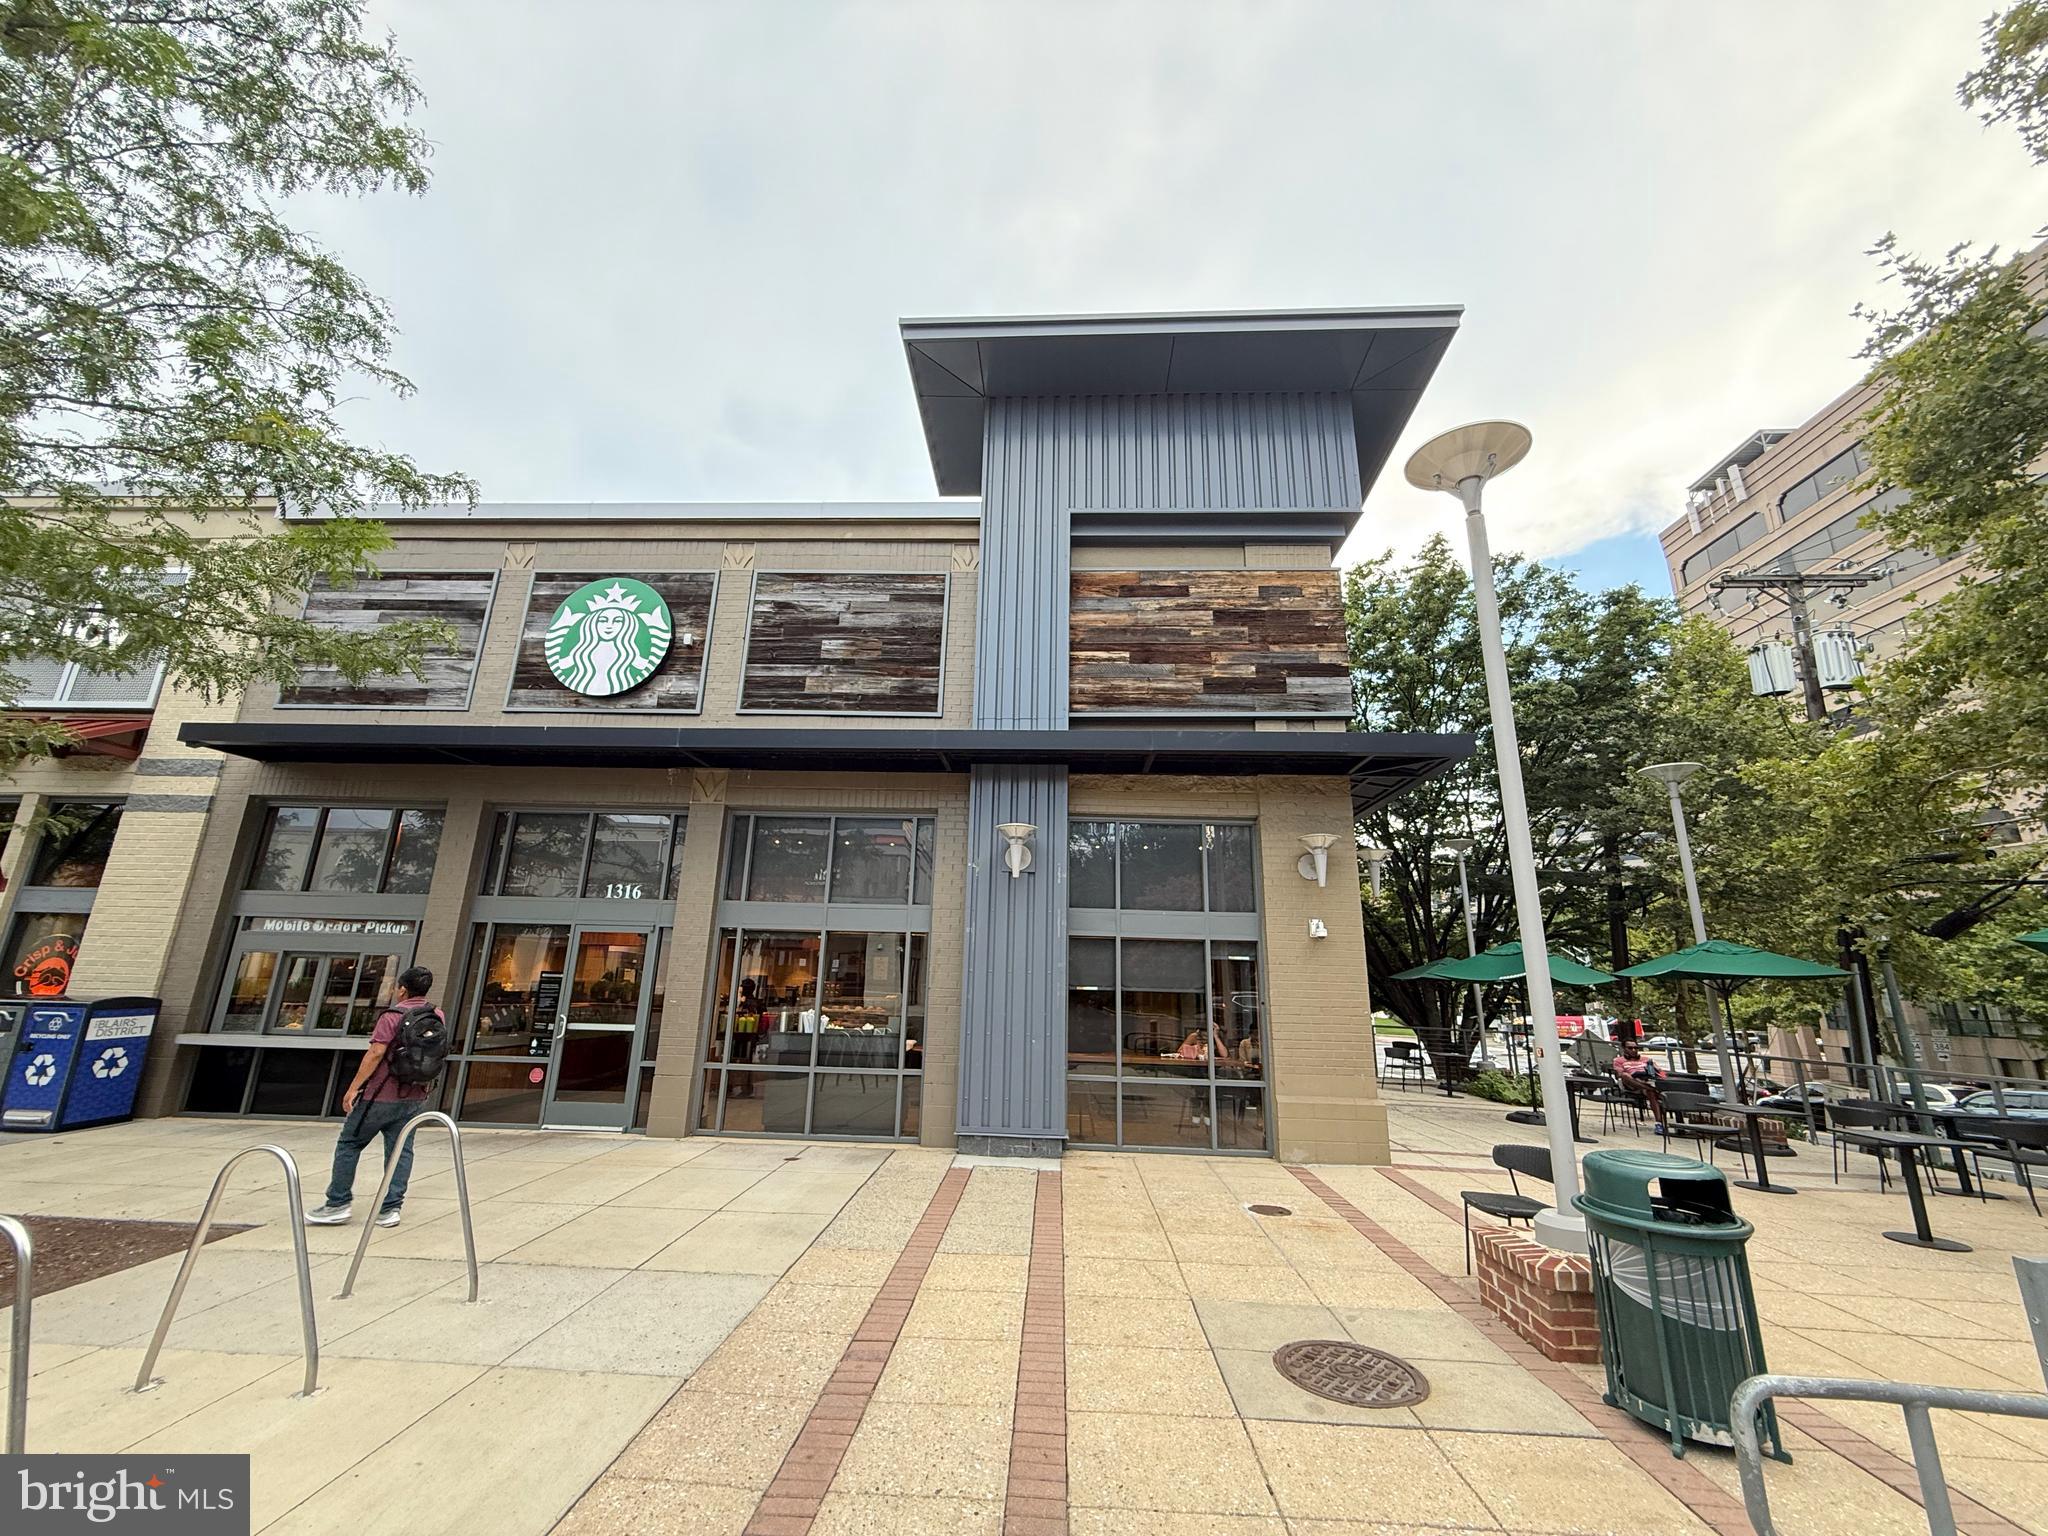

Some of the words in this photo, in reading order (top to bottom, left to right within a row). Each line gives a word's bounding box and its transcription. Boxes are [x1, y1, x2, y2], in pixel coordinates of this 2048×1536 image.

[605, 883, 643, 900] 1316
[263, 919, 310, 931] Mobile
[312, 919, 362, 933] Order
[364, 920, 408, 934] Pickup
[14, 945, 51, 977] Crisp
[54, 939, 65, 952] &
[98, 1018, 138, 1028] BLAIRS
[95, 1025, 147, 1037] DISTRICT
